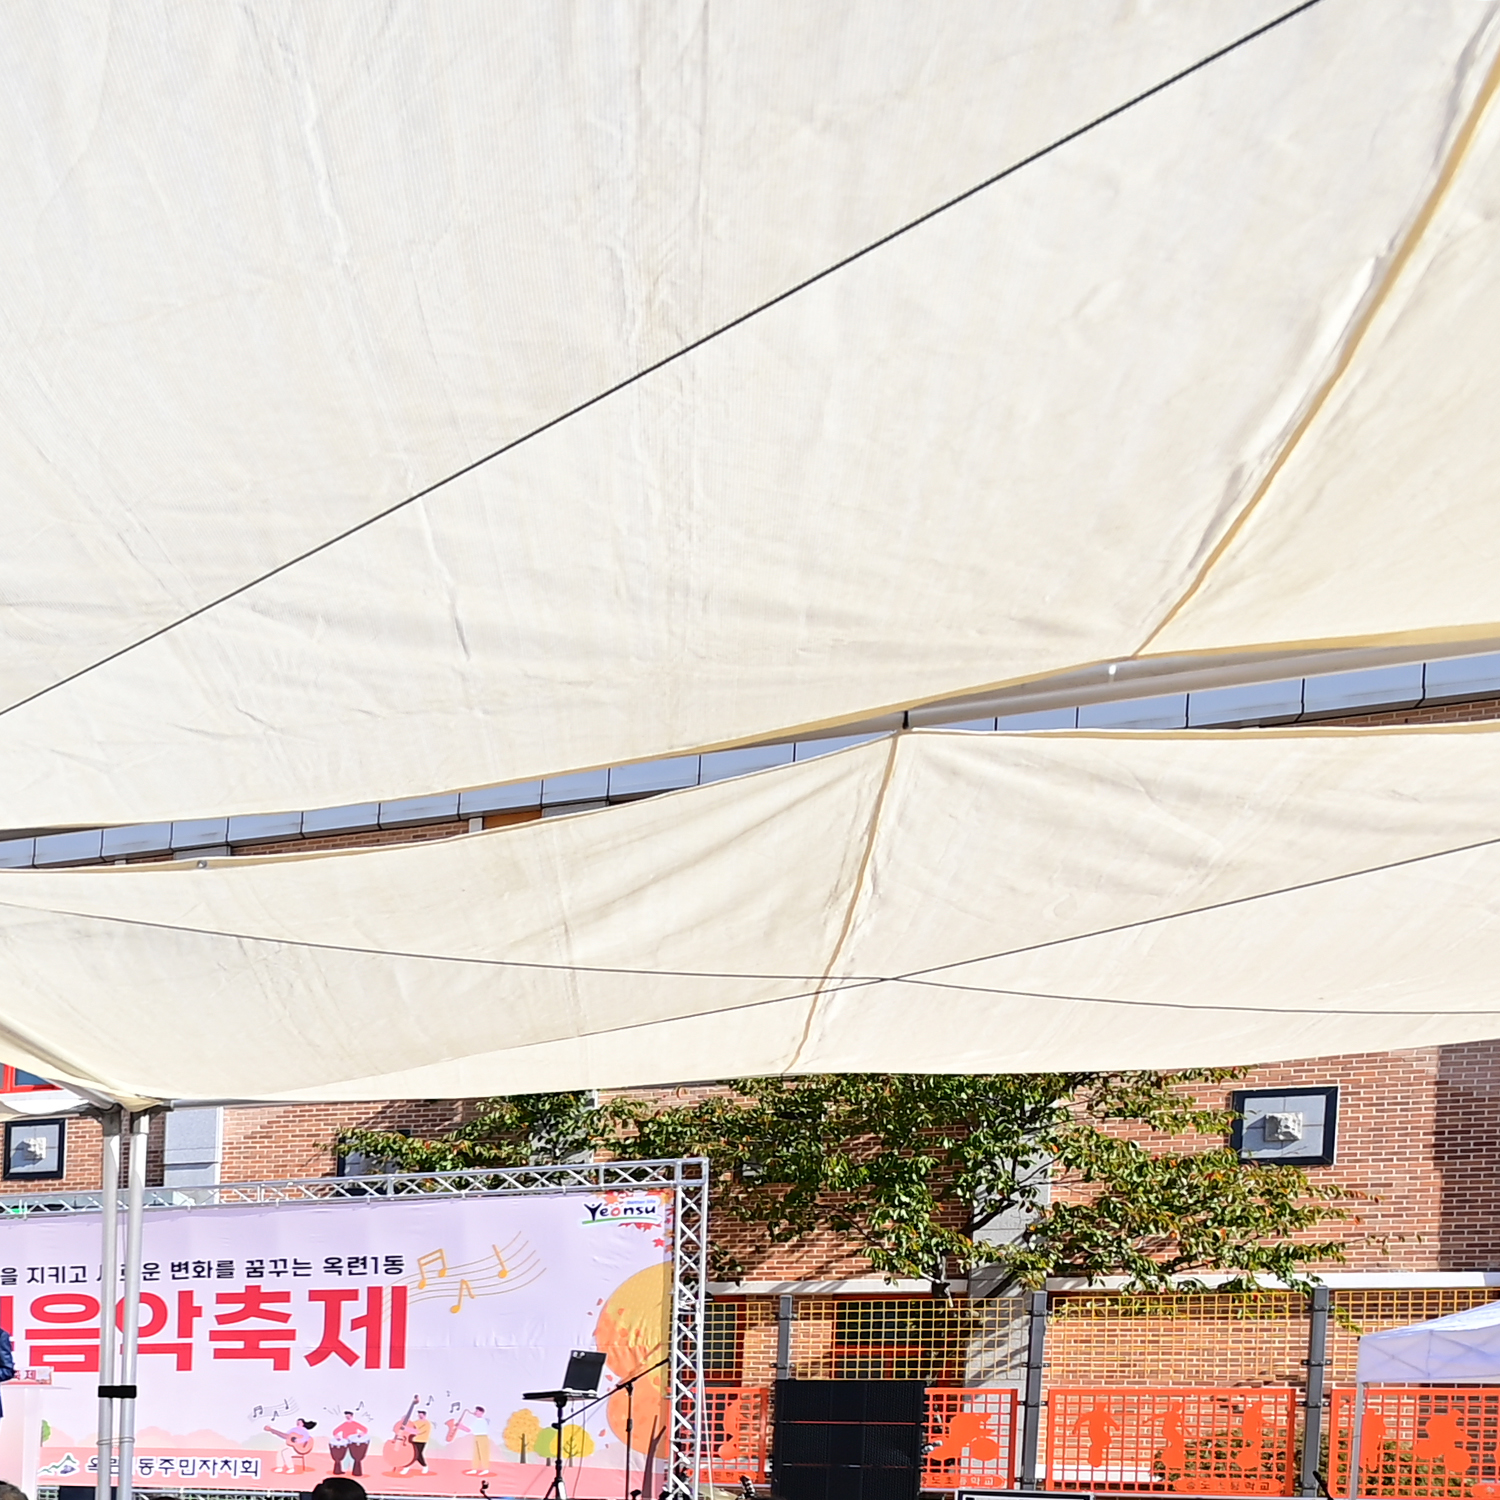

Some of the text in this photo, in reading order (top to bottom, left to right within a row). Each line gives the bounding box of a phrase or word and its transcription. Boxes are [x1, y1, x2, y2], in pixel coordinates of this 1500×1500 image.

[583, 1202, 656, 1222] Yeonsu
[26, 1264, 88, 1285] 지키고
[170, 1259, 235, 1281] 변화를
[244, 1256, 313, 1279] 꿈꾸는
[321, 1253, 405, 1277] 옥련1동
